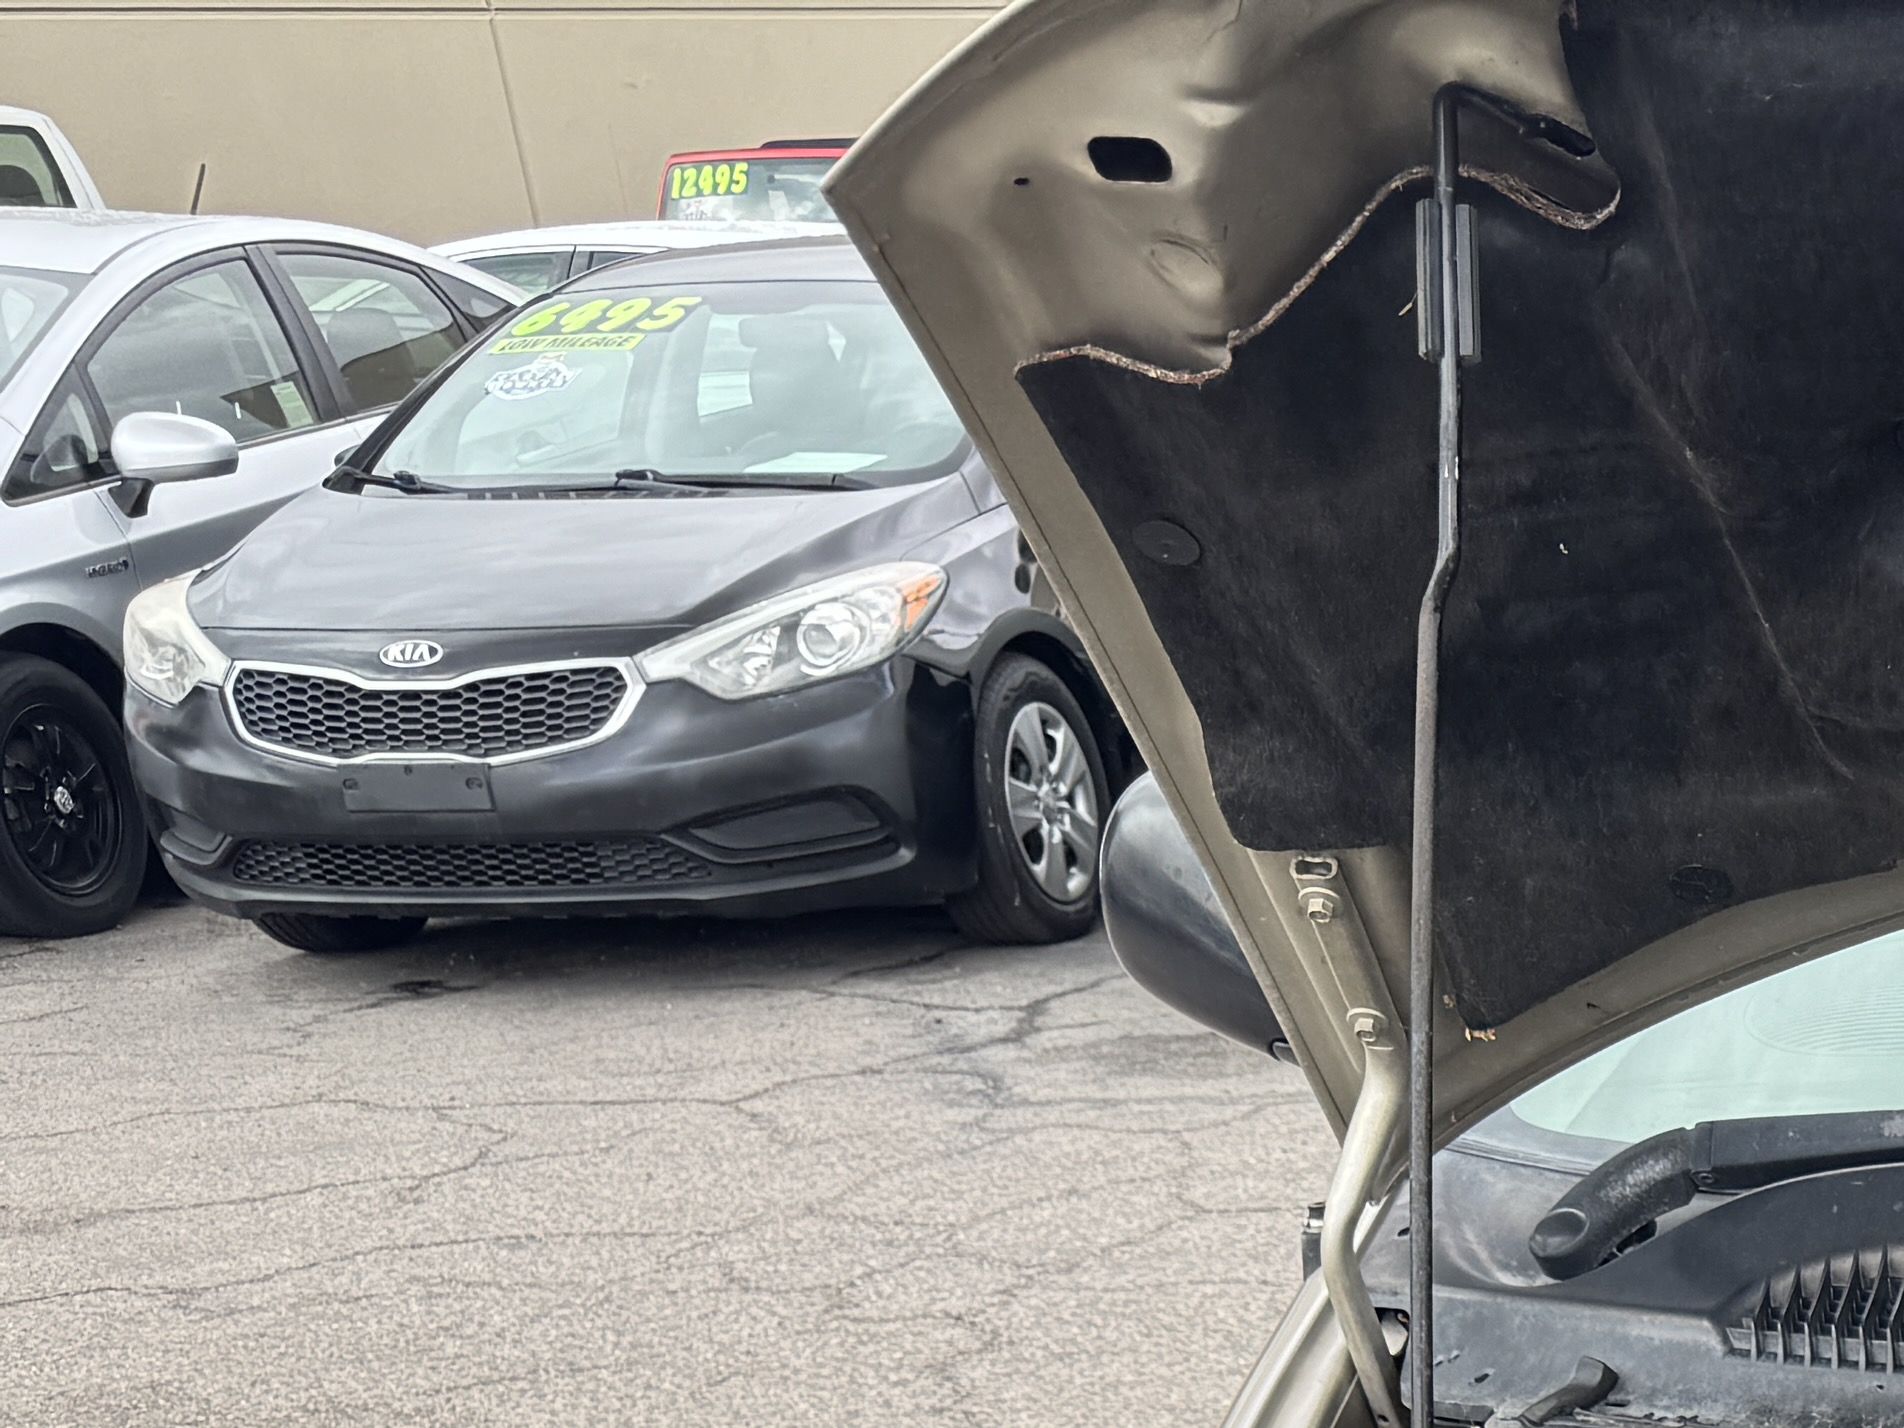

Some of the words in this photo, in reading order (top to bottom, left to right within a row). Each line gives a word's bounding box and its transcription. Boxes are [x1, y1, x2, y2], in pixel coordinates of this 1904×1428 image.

[671, 162, 749, 200] 12495
[511, 297, 702, 336] 6495
[499, 337, 542, 351] LOW
[542, 334, 636, 349] MILEAGE
[387, 643, 431, 662] KIA
